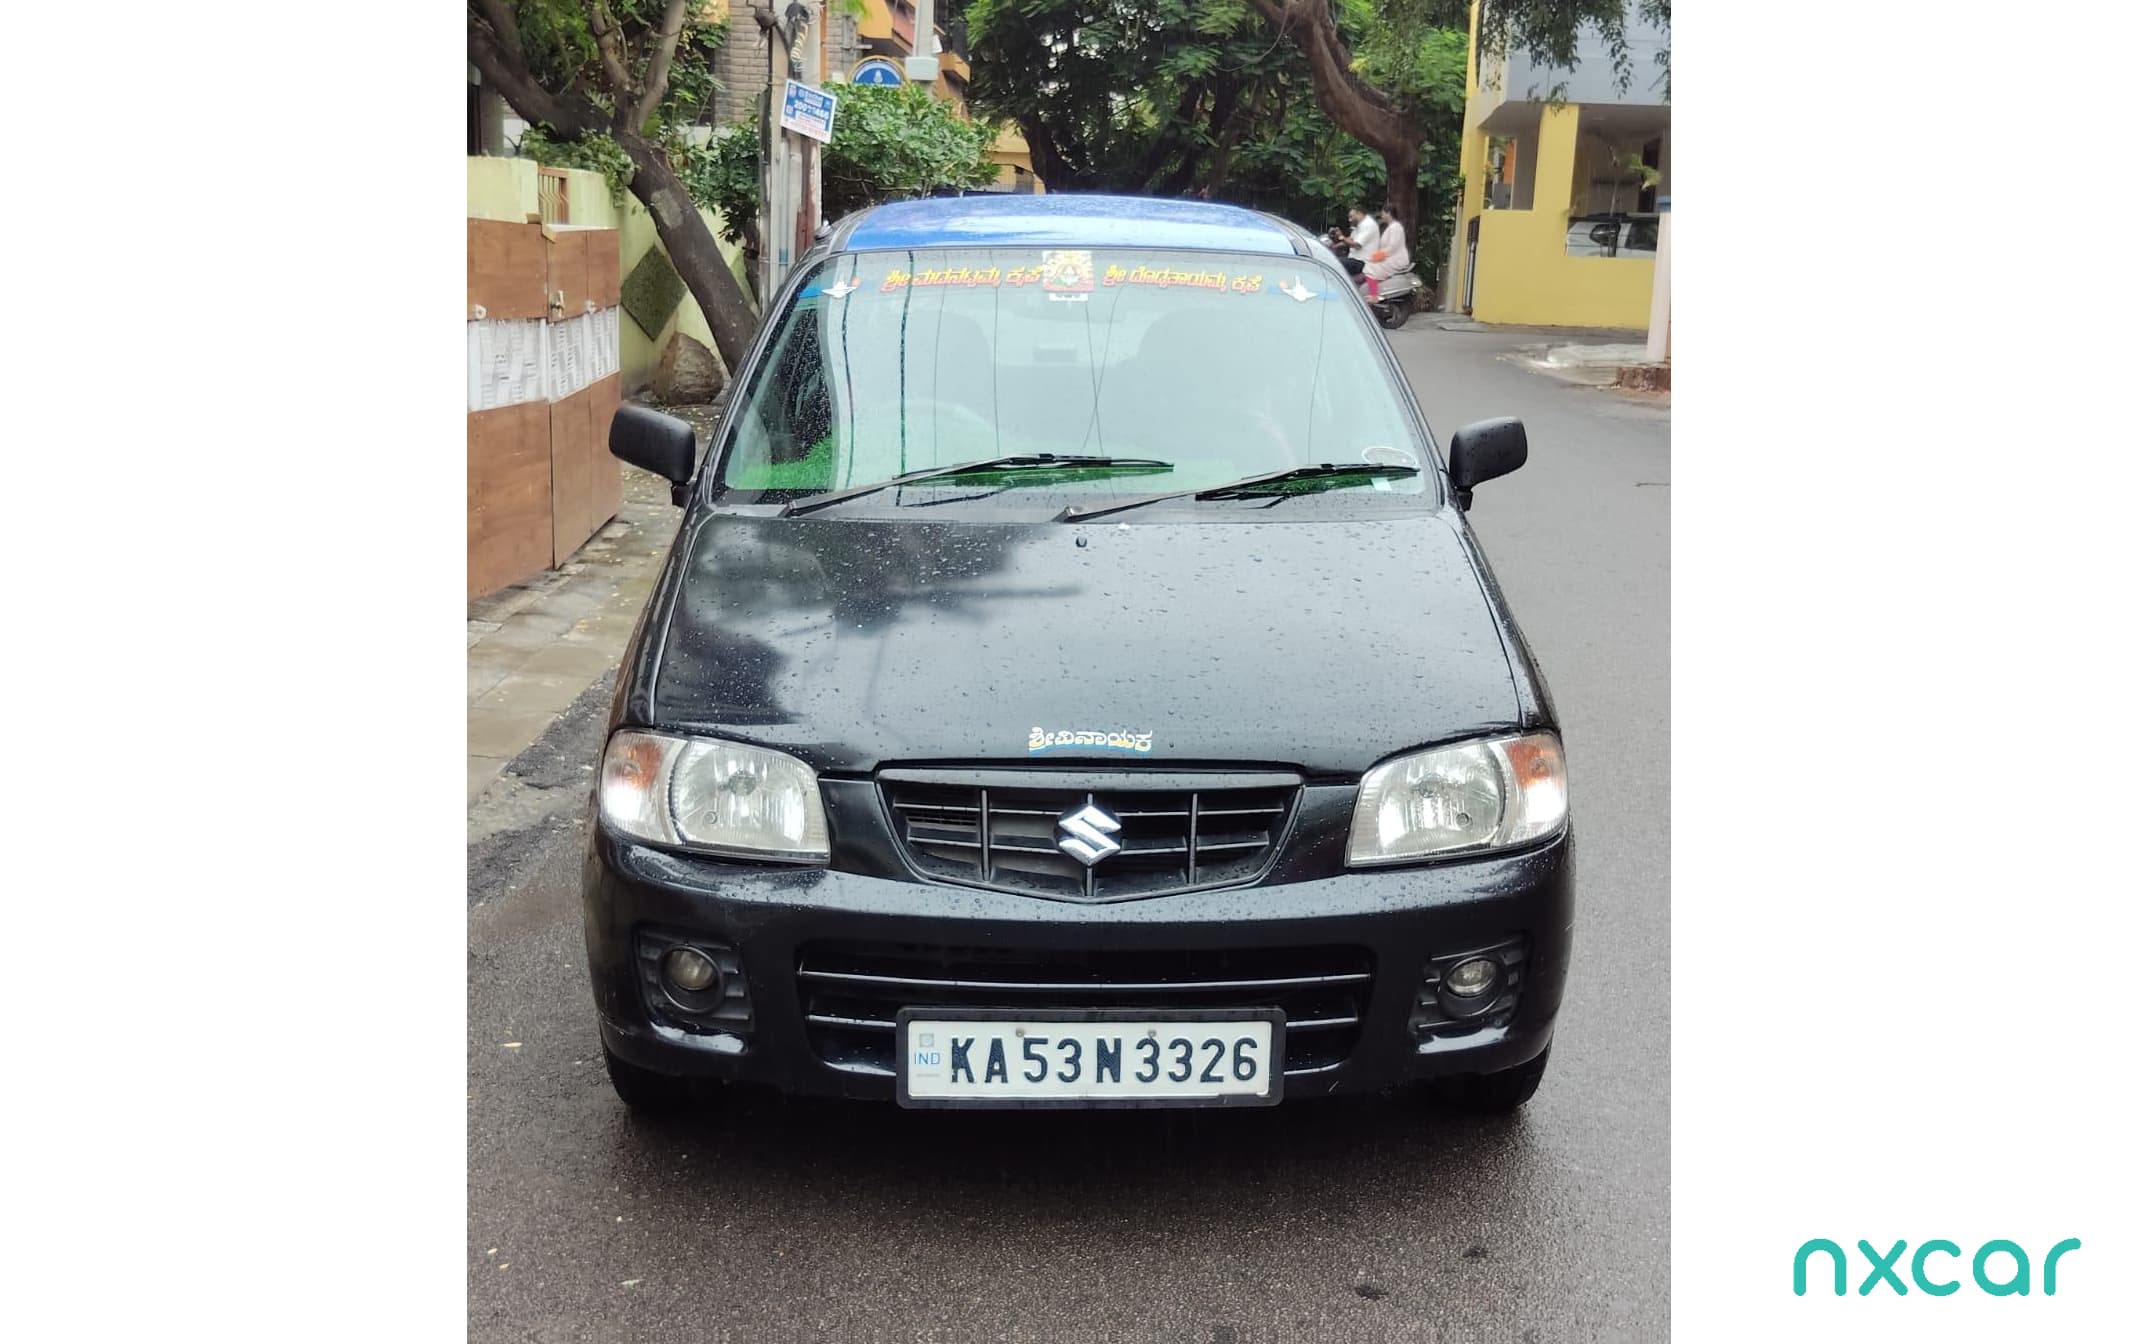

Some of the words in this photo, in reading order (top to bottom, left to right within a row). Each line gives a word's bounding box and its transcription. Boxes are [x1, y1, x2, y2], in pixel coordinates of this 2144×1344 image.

[1103, 264, 1127, 287] ಶ್ರೀ
[1028, 726, 1153, 752] ಶ್ರೀವಿನಾಯಕ
[913, 1051, 941, 1066] IND
